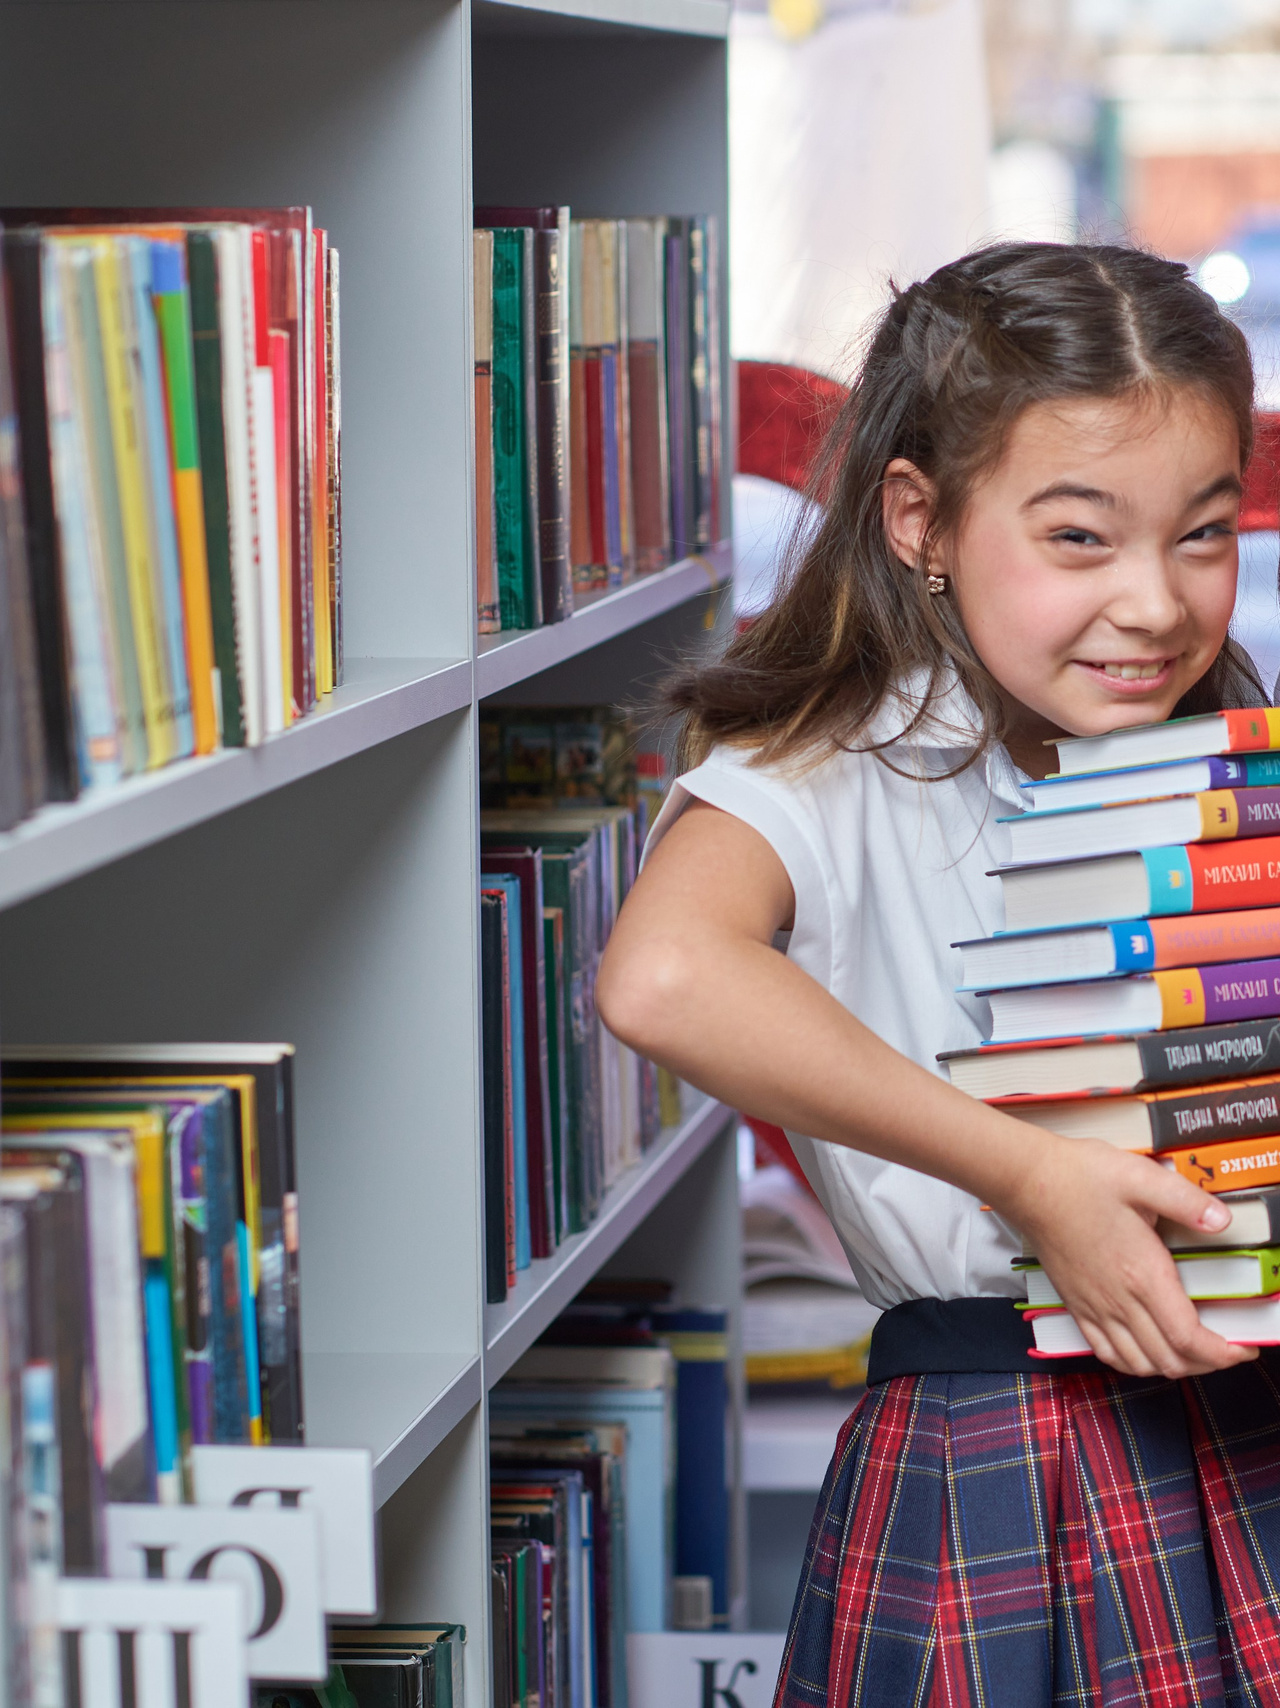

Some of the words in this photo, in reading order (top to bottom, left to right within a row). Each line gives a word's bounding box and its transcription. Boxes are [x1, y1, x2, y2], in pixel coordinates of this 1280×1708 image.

[1204, 863, 1261, 885] МИХАИЛ
[1214, 978, 1269, 1003] МИХАИЛ
[1163, 1043, 1202, 1072] ТАТЬЯНА
[1204, 1034, 1264, 1064] МАСТРЮКОВА
[1173, 1106, 1214, 1136] ТАТЬЯНА
[1216, 1096, 1279, 1127] МАСТРЮКОВА
